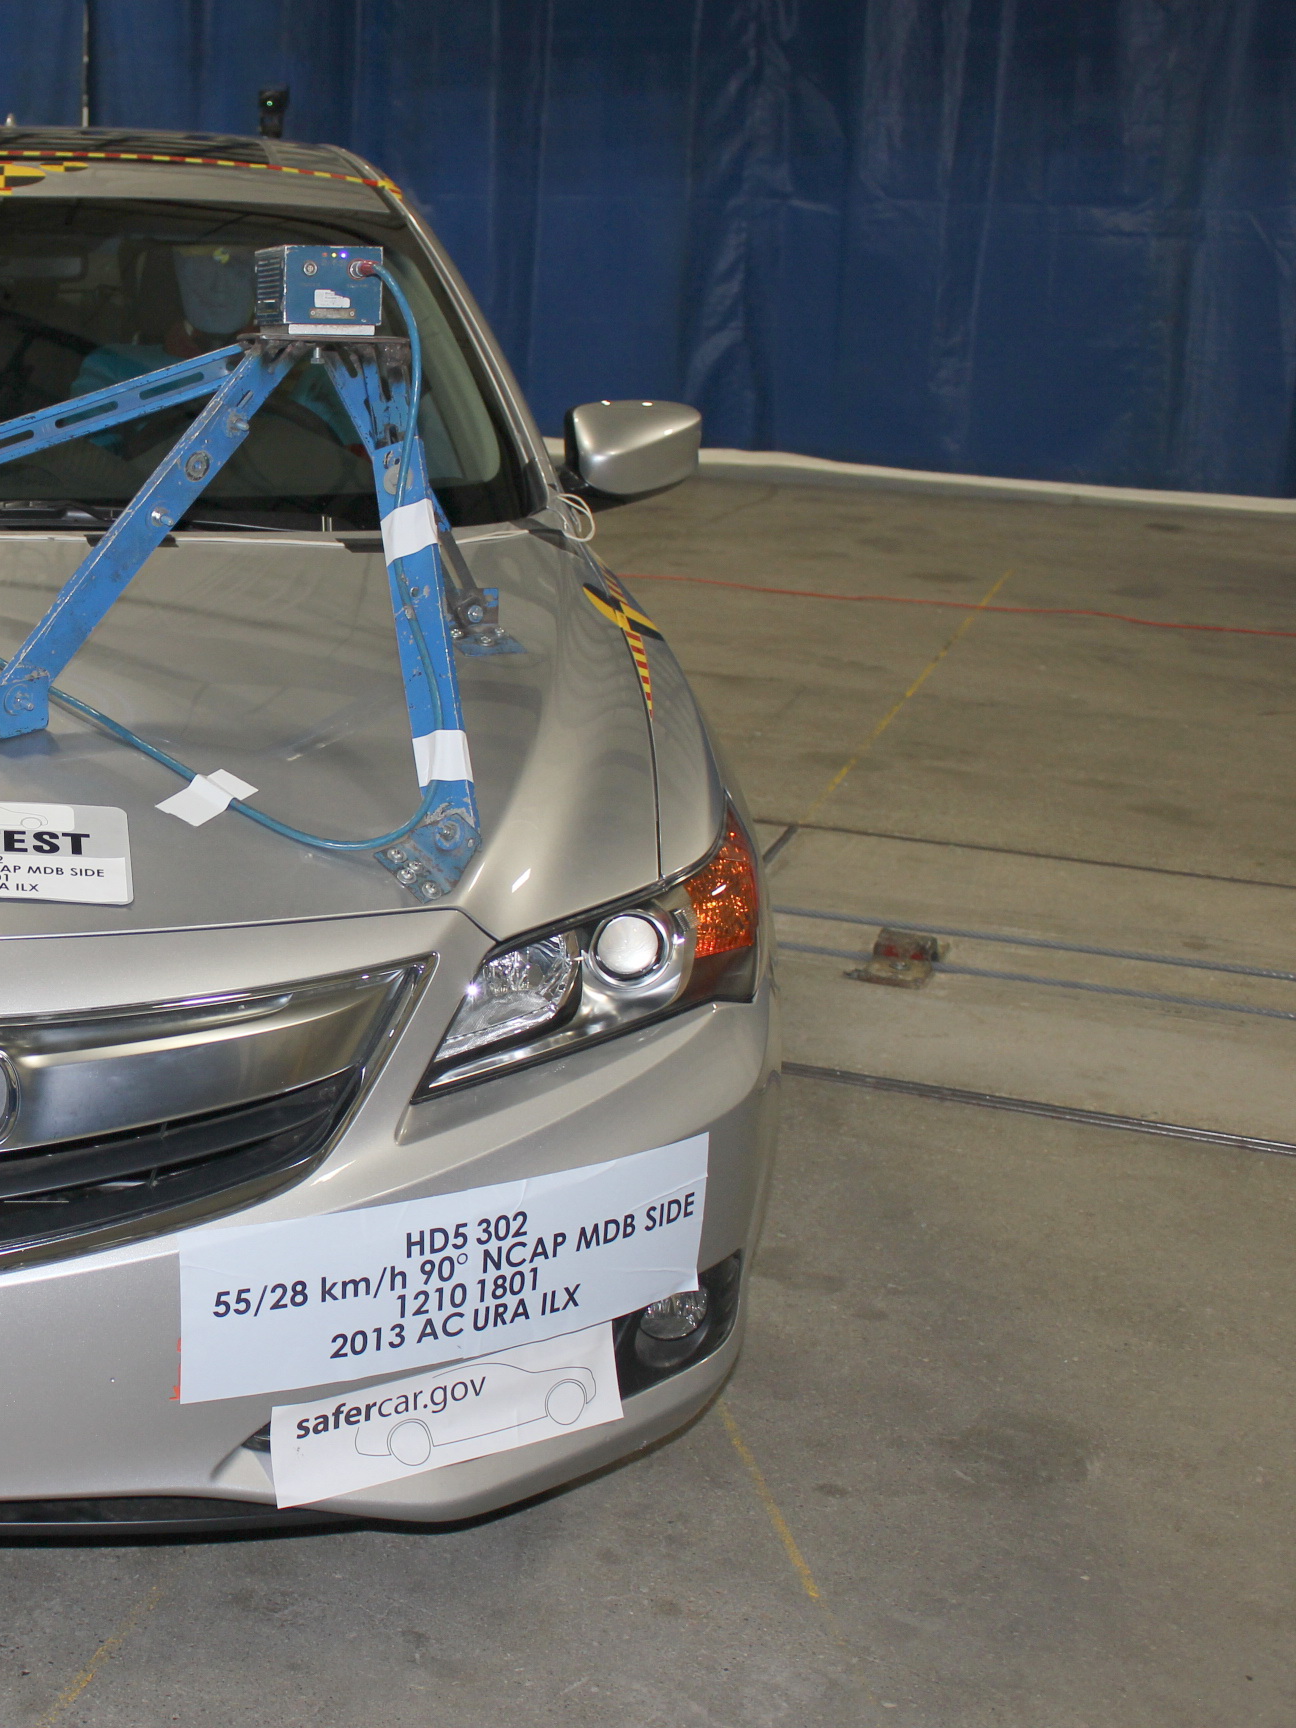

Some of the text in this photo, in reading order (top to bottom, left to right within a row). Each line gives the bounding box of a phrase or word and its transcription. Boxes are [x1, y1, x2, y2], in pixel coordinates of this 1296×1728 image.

[16, 883, 39, 892] ILX
[27, 866, 64, 875] MDB
[70, 868, 104, 877] SIDE
[213, 1280, 308, 1318] 55/28
[320, 1266, 407, 1303] km/h
[482, 1232, 567, 1272] NCAP
[575, 1215, 636, 1253] MDB
[644, 1192, 695, 1231] SIDE
[330, 1325, 406, 1359] 2013
[541, 1284, 581, 1317] ILX
[296, 1376, 486, 1439] safercar.gov
